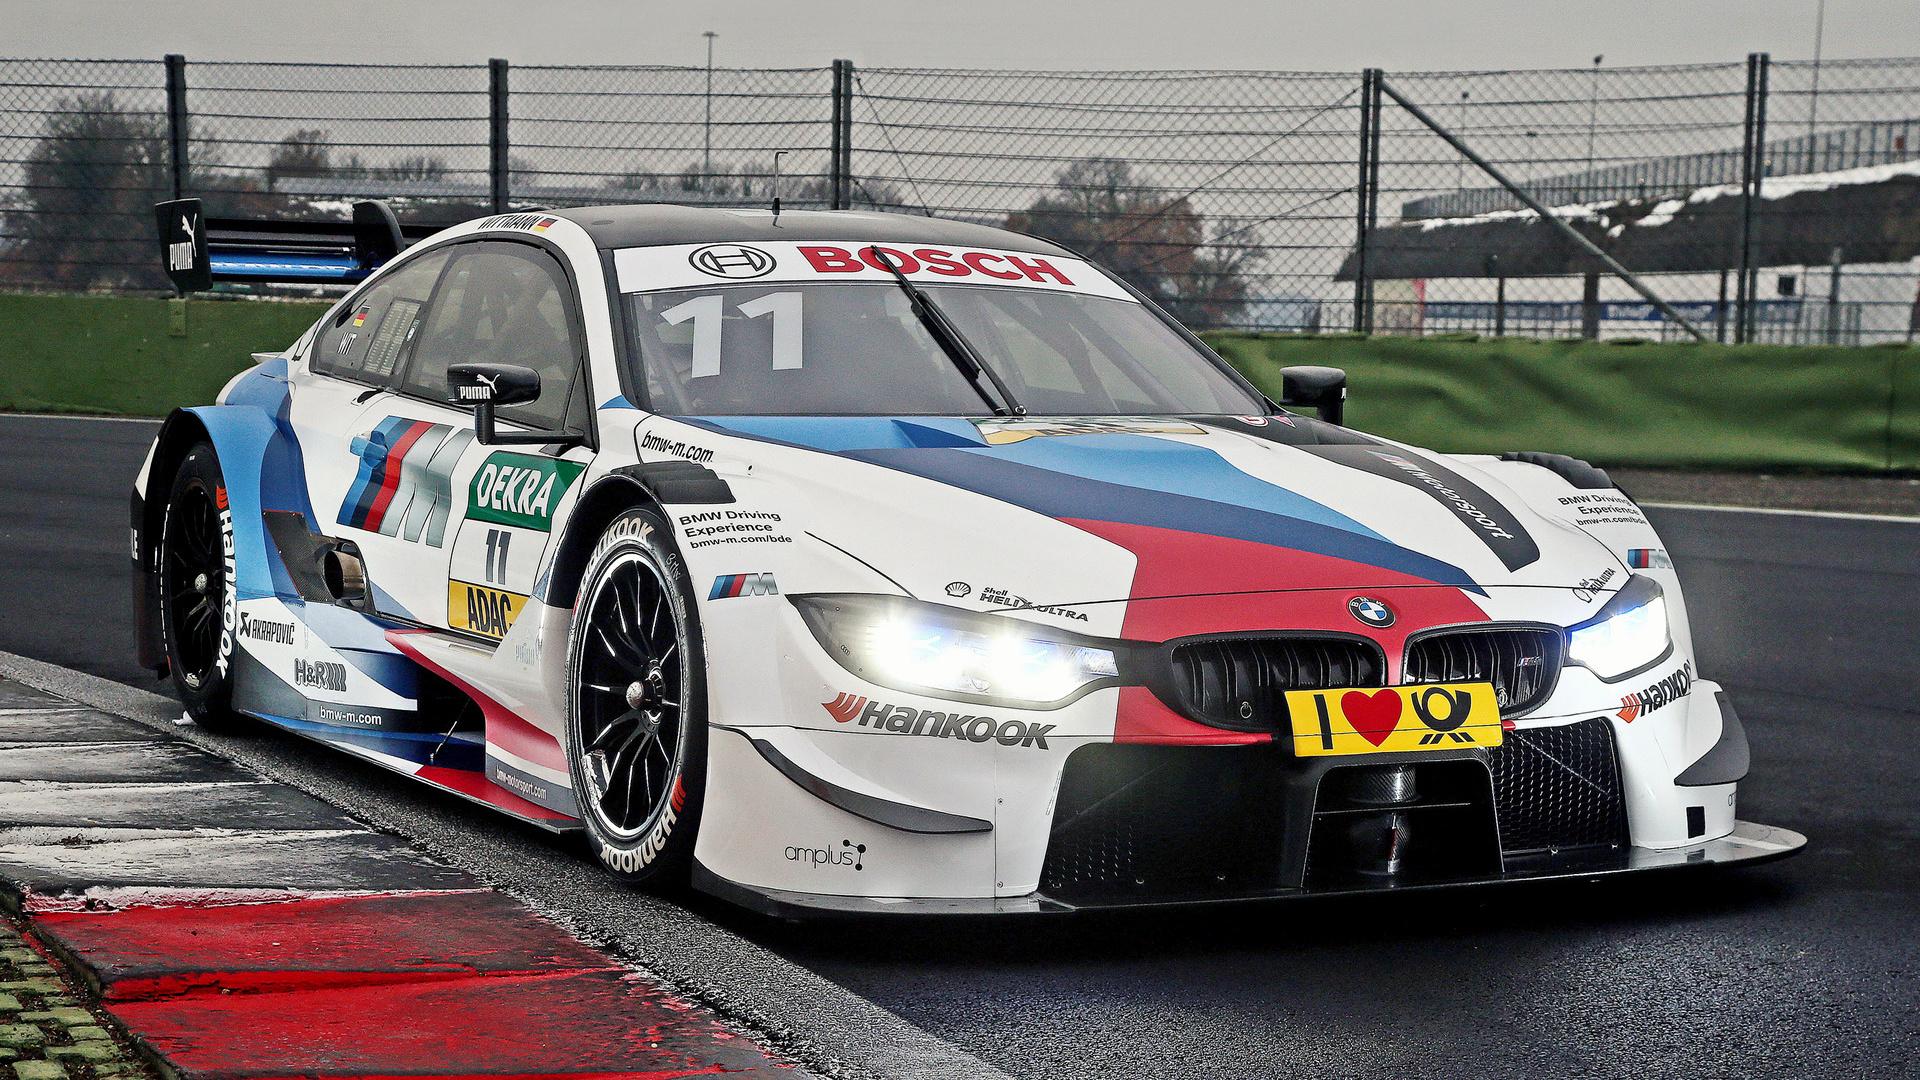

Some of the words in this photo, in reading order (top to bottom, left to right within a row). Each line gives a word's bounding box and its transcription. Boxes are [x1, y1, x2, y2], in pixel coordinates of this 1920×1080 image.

[169, 241, 193, 272] PUMA
[796, 245, 1077, 287] BOSCH
[336, 331, 358, 355] WIT
[660, 290, 803, 379] 11
[459, 385, 491, 400] PUMA
[640, 429, 715, 463] bmw-m.com
[476, 463, 558, 518] DEKRA
[1558, 494, 1591, 506] BMW
[678, 510, 722, 526] BMW
[725, 510, 782, 522] Driving
[1577, 505, 1641, 516] Experience
[684, 522, 773, 538] Experience
[689, 534, 793, 550] bmw-m.com/bde
[485, 528, 512, 586] 11
[983, 586, 1009, 597] Shell
[466, 586, 513, 637] ADAC
[1036, 604, 1089, 623] ULTRA
[293, 657, 329, 691] H&R
[319, 705, 383, 726] bmw-m.com
[1312, 693, 1334, 750] I
[784, 844, 854, 869] amplus
